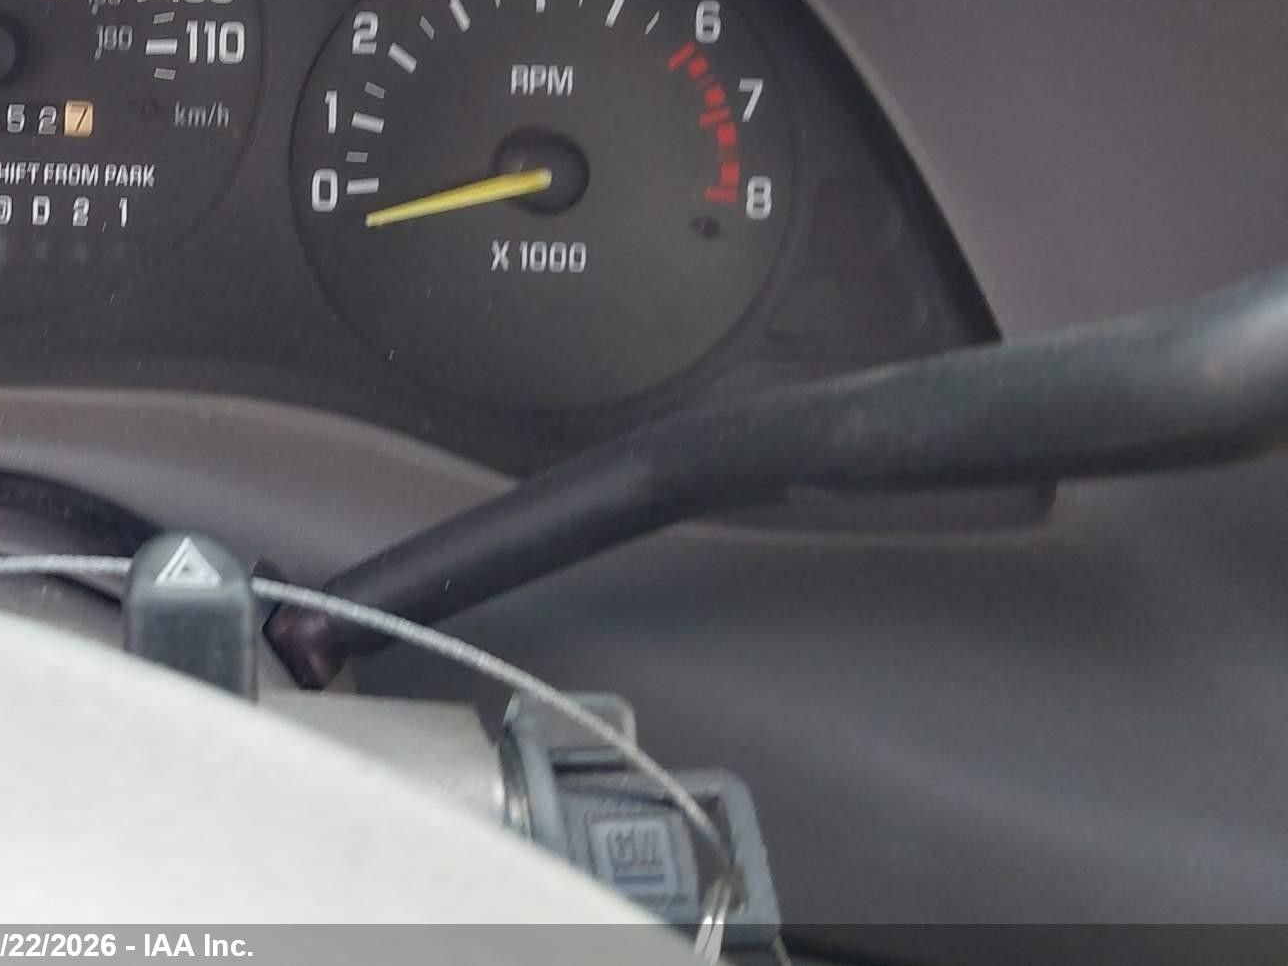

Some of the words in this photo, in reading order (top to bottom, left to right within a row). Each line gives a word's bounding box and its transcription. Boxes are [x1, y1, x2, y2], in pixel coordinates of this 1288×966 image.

[186, 20, 245, 64] 110
[352, 11, 379, 55] 2
[695, 0, 722, 44] 6
[510, 65, 575, 97] RPM
[737, 78, 765, 123] 7
[174, 101, 230, 128] km/h
[325, 90, 338, 135] 1
[43, 163, 99, 187] FROM
[104, 164, 156, 188] PARK
[311, 168, 339, 213] 0
[32, 195, 51, 226] D
[72, 196, 90, 227] 2
[118, 197, 129, 228] 1
[745, 176, 773, 221] 8
[491, 239, 510, 273] X
[518, 240, 588, 273] 1000
